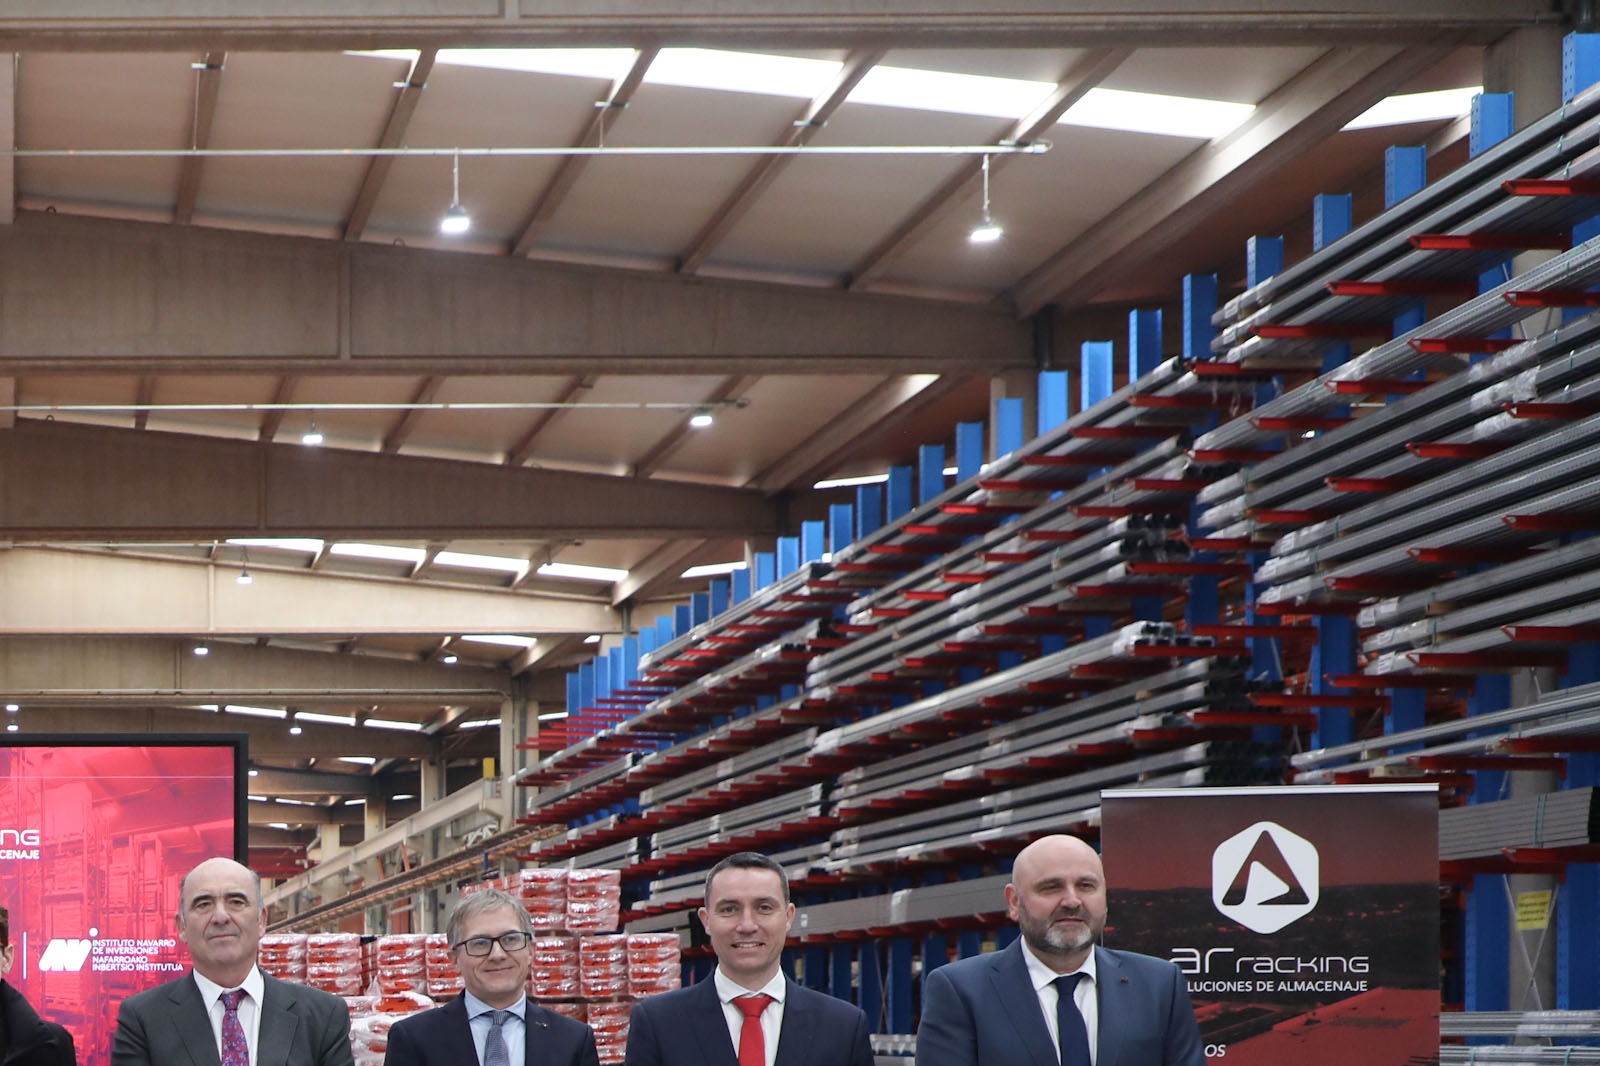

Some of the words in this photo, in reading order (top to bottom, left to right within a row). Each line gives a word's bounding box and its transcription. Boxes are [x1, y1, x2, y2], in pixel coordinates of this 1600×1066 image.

[92, 939, 135, 947] INSTITUTO
[137, 939, 176, 947] NAVARRO
[1187, 980, 1252, 992] LUCIONES
[1256, 980, 1275, 992] DE
[1277, 980, 1368, 993] ALMACENAJE
